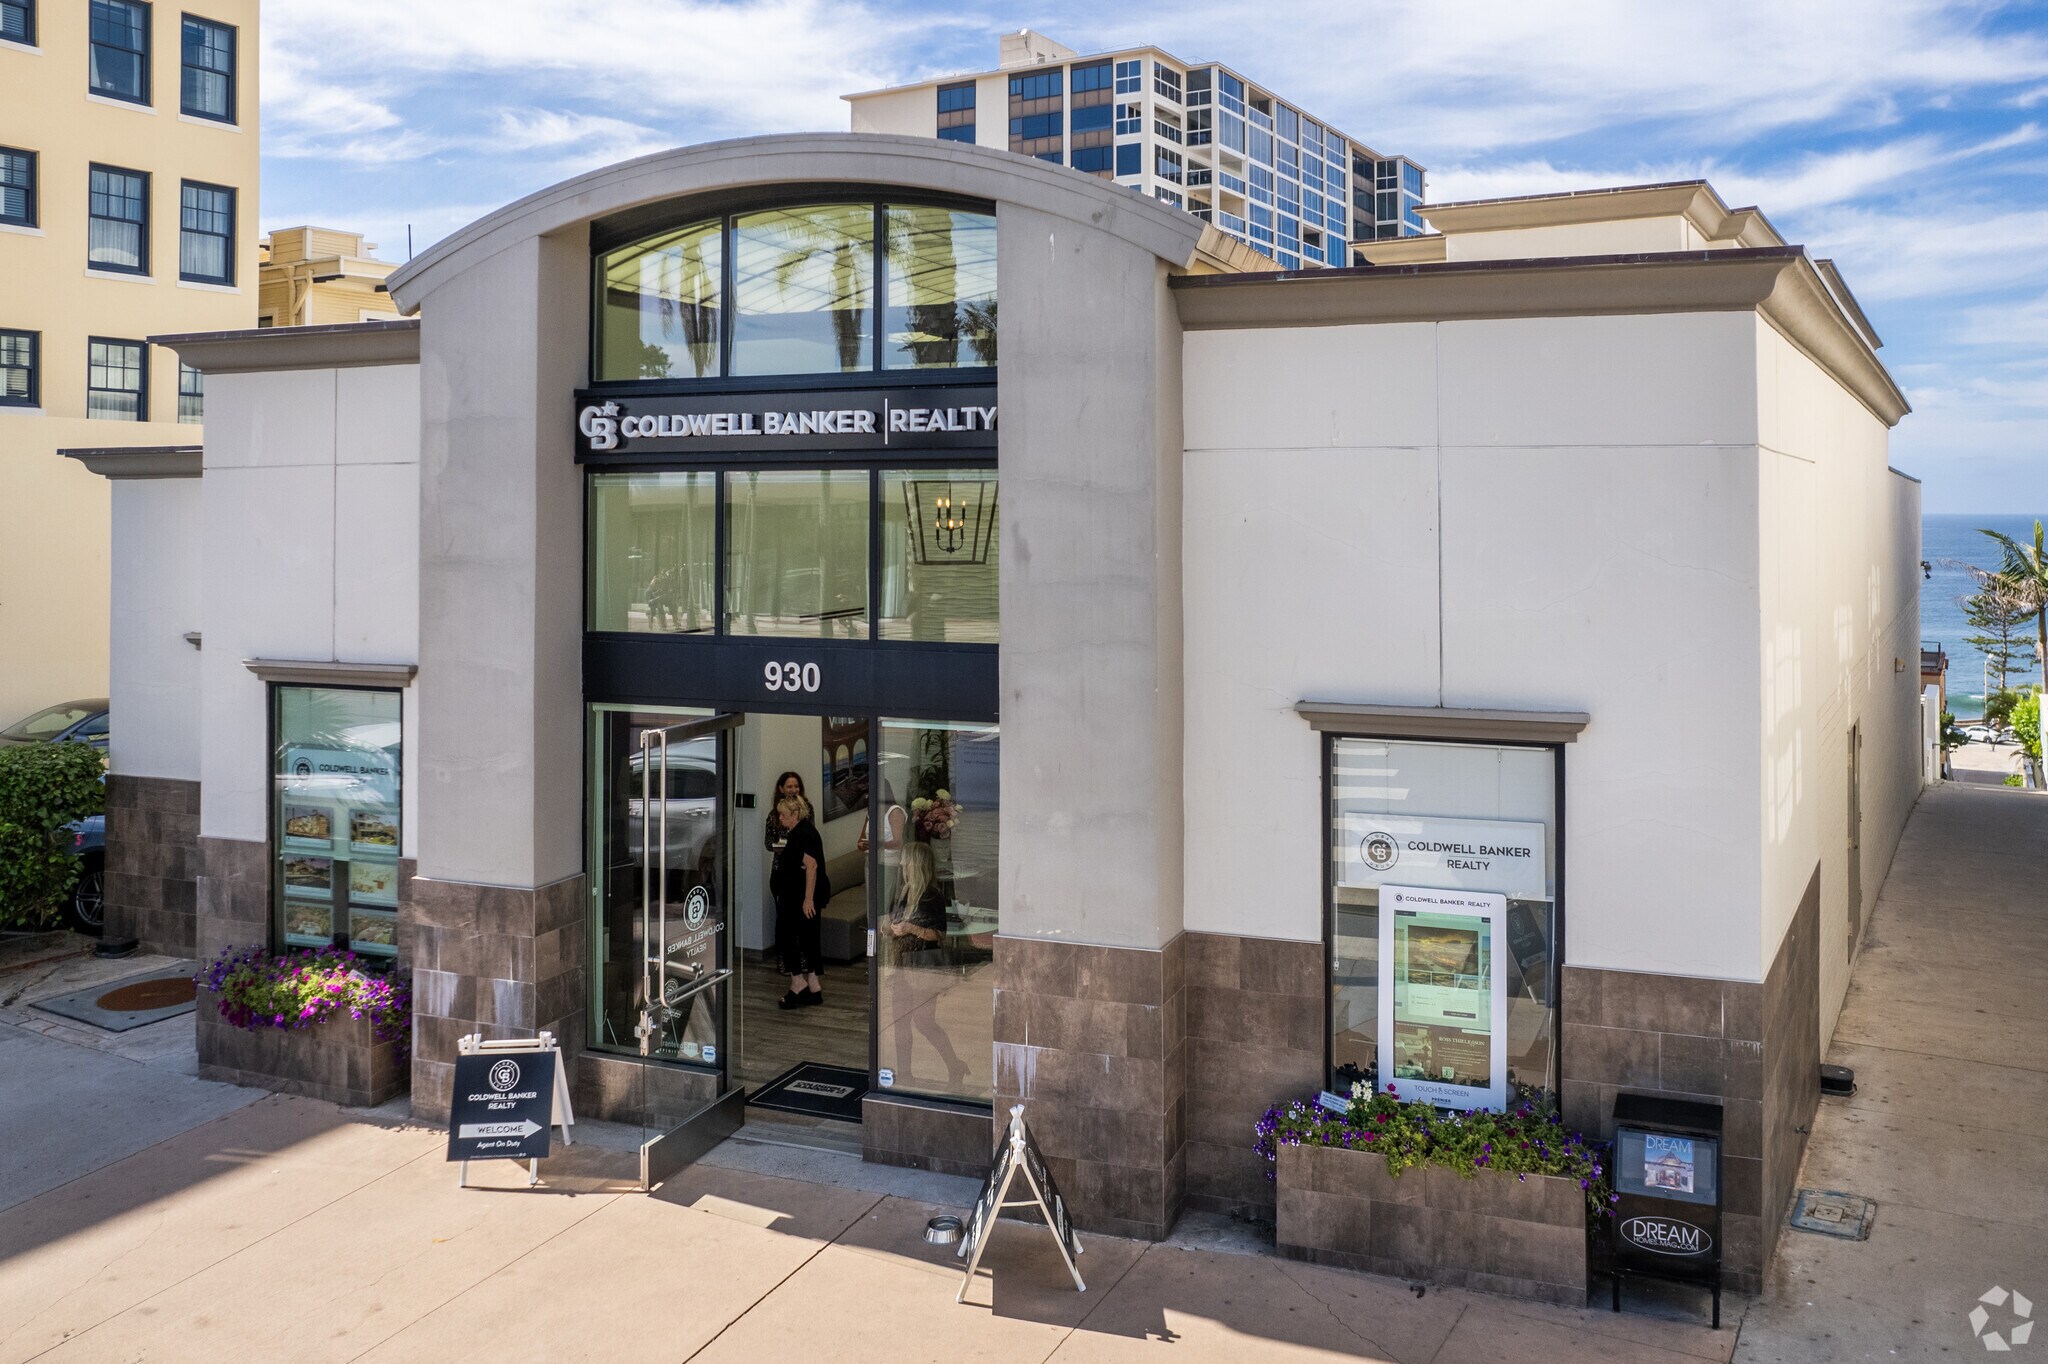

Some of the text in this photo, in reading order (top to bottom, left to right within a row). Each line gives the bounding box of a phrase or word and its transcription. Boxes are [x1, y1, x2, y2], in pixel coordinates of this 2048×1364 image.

[620, 412, 762, 438] COLDWELL
[764, 409, 876, 434] BANKER
[890, 406, 998, 432] REALTY
[764, 661, 821, 692] 930
[319, 763, 359, 774] COLDWELL
[360, 766, 391, 776] BANKER
[1407, 840, 1531, 858] COLDWELL BANKER
[1447, 859, 1490, 871] REALTY
[1405, 895, 1438, 904] COLDWELL
[1440, 898, 1465, 906] BANKER
[468, 1091, 537, 1102] COLDWELL BANKER
[1414, 1085, 1470, 1097] TOUCH SCREEN
[487, 1101, 517, 1110] REALTY
[477, 1124, 524, 1134] WELCOME
[476, 1141, 496, 1149] Agent
[506, 1140, 521, 1148] Duty
[1645, 1136, 1691, 1153] DREAM
[1633, 1220, 1699, 1245] DREAM
